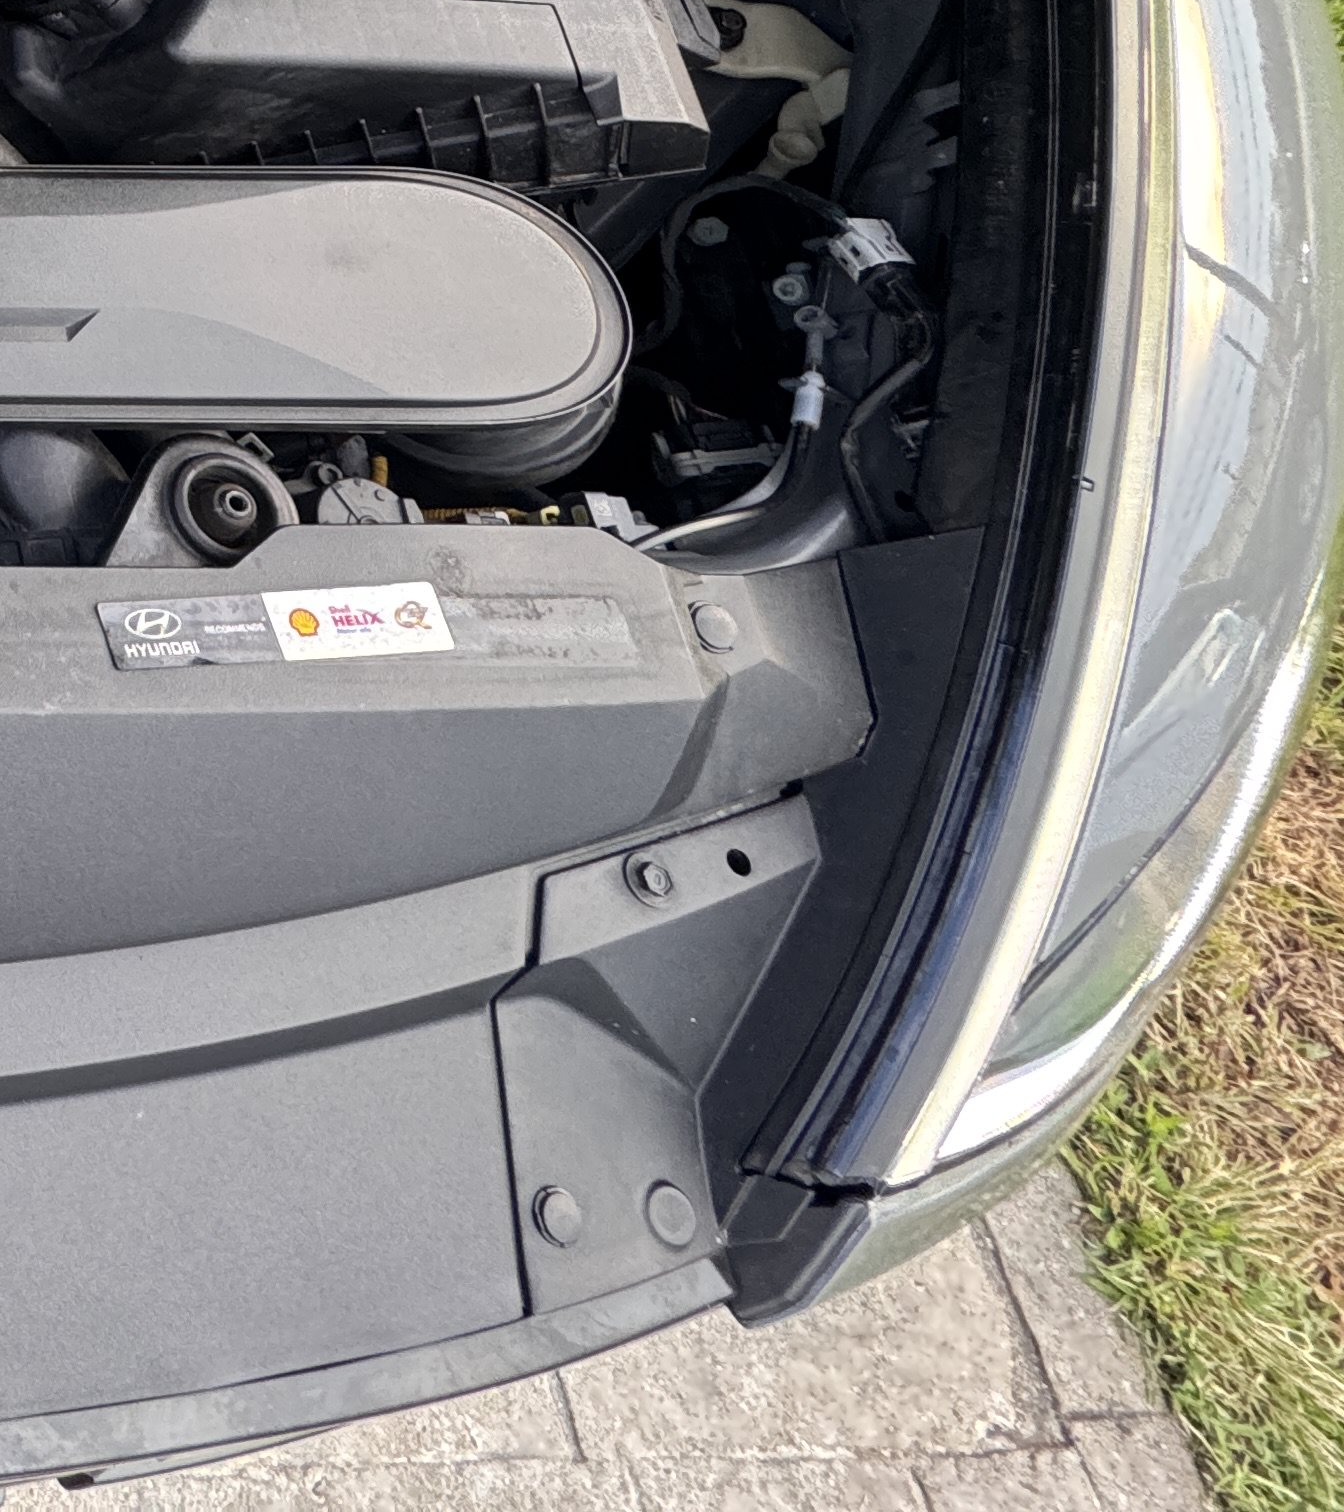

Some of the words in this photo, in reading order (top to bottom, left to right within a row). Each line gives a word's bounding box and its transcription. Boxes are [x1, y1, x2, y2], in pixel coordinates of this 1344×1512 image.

[328, 604, 351, 614] Shell
[331, 608, 385, 627] HELIX
[204, 622, 266, 634] RECOMMENDS
[123, 640, 200, 658] HYUNDAI
